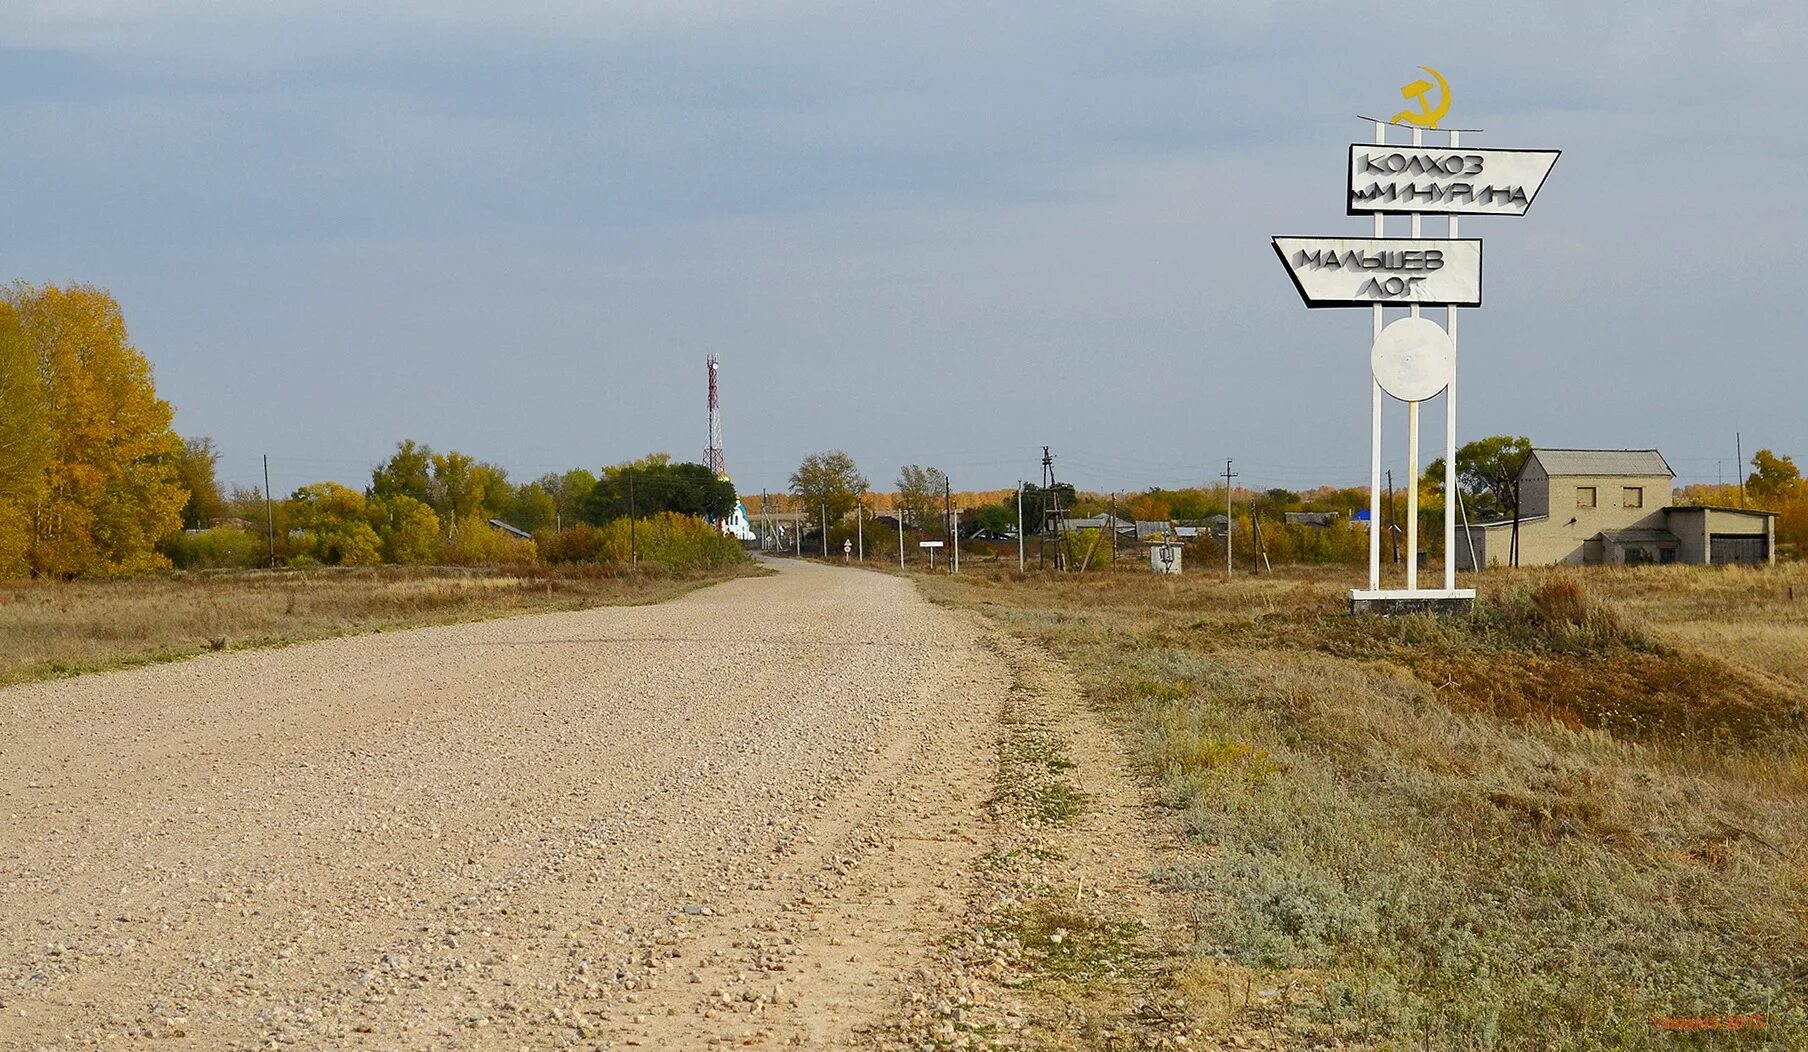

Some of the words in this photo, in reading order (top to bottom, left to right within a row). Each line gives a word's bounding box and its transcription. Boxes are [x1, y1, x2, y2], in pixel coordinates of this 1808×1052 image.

[1364, 152, 1485, 175] КОЛХОЗ
[1300, 248, 1446, 270] МАЛЫШЕВ
[1363, 276, 1428, 296] ЛОГ
